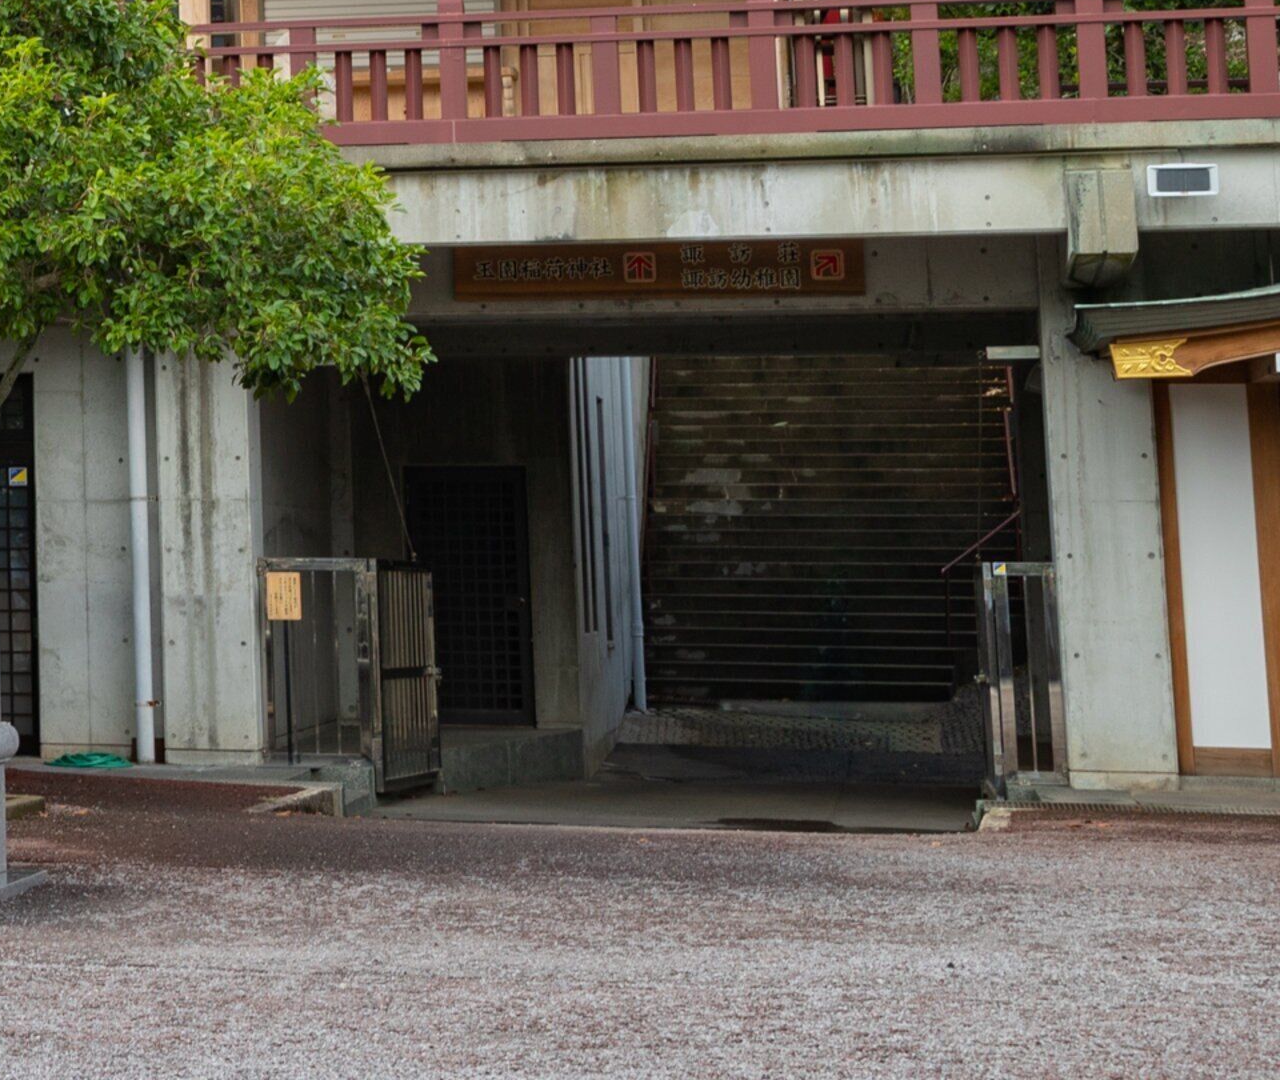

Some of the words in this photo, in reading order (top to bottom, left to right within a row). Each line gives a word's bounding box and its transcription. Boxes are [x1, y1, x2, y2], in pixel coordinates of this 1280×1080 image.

[473, 256, 615, 282] 玉園稲荷神社
[680, 266, 803, 290] 諏訪幼稚園
